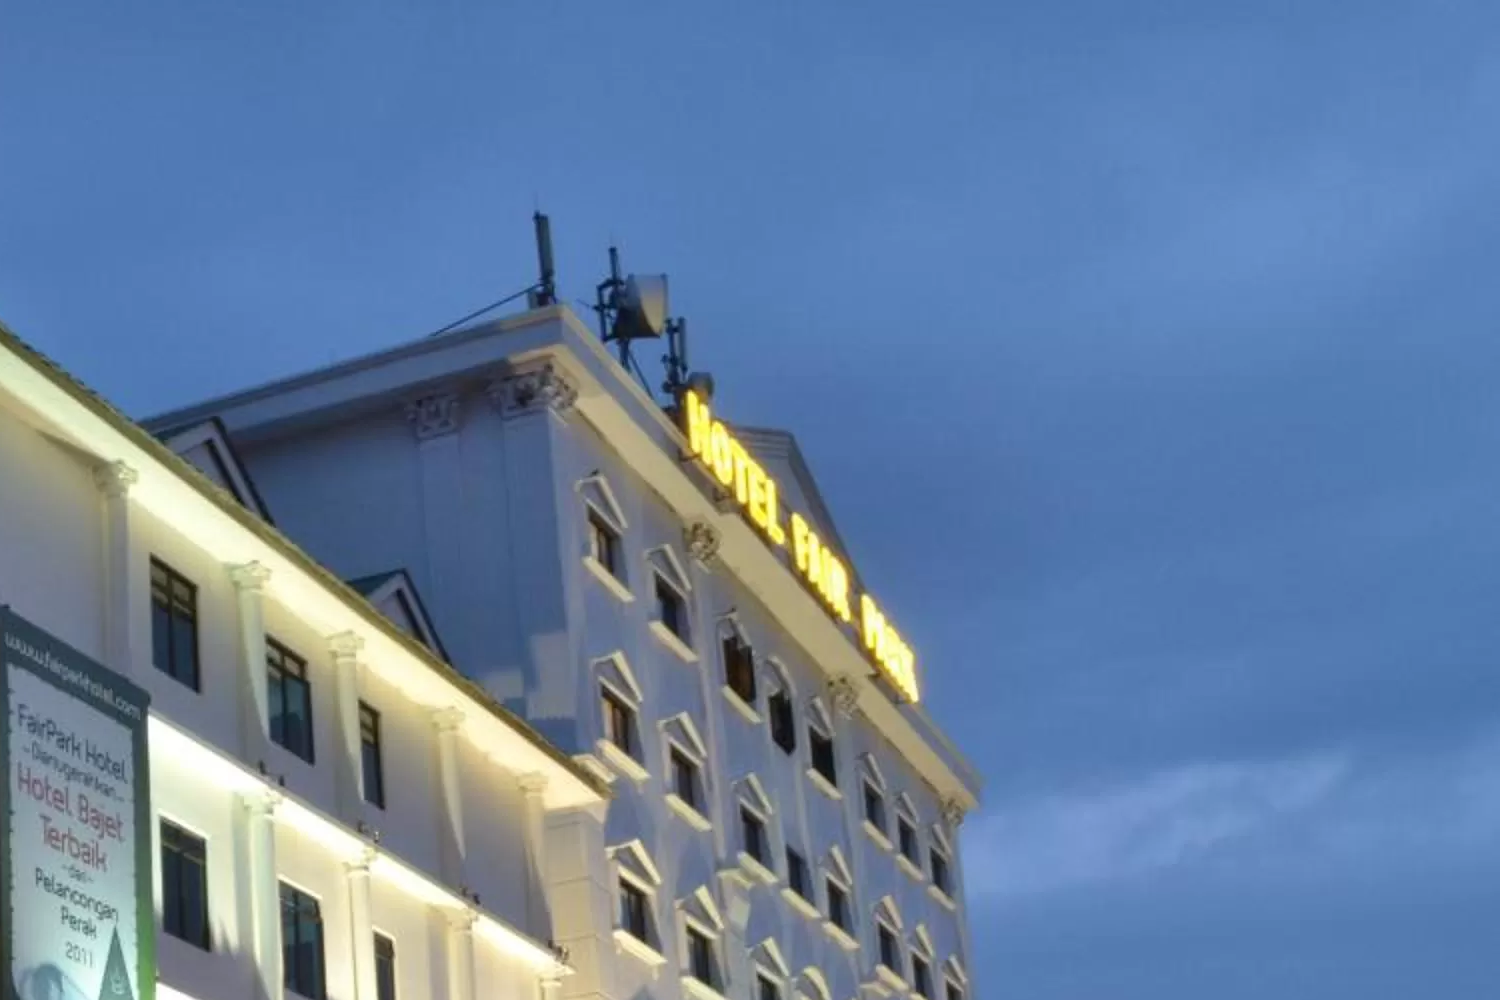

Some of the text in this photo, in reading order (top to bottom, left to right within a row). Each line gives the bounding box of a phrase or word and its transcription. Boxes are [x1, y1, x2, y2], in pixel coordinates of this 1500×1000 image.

[687, 390, 785, 544] HOTEL
[18, 703, 129, 785] FairPark Hotel
[18, 760, 127, 842] Hotel Bajet
[40, 813, 108, 872] Terbaik
[61, 905, 98, 940] Perak
[66, 941, 94, 969] 2011
